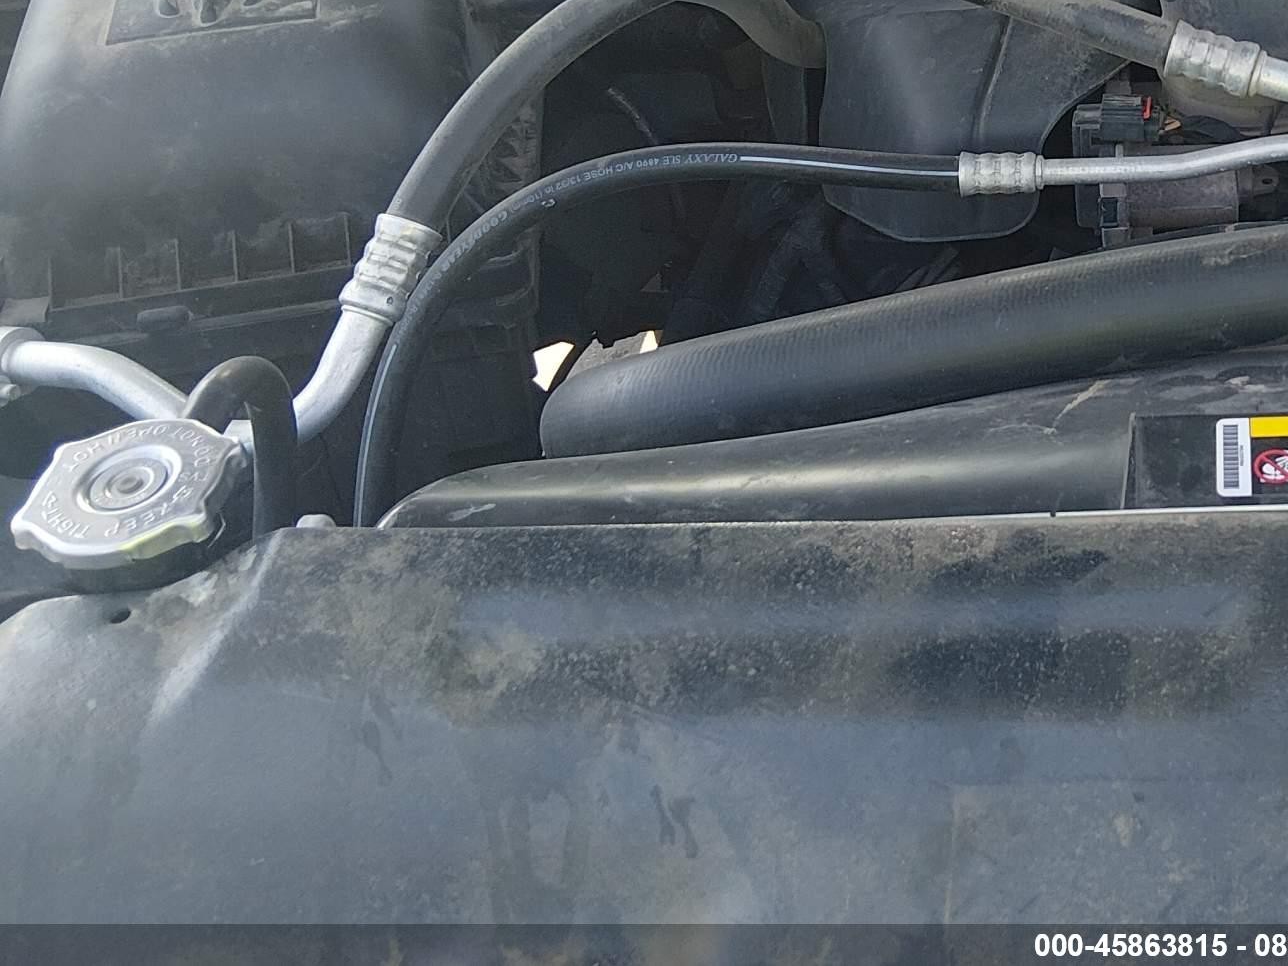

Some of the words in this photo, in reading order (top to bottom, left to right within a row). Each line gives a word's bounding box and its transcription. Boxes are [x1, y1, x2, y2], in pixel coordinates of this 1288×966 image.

[663, 155, 681, 165] SLE
[684, 153, 738, 164] GALAXY
[615, 161, 633, 172] A/C
[583, 167, 613, 181] HOSE
[63, 441, 103, 473] HOT
[104, 500, 171, 538] KEEP
